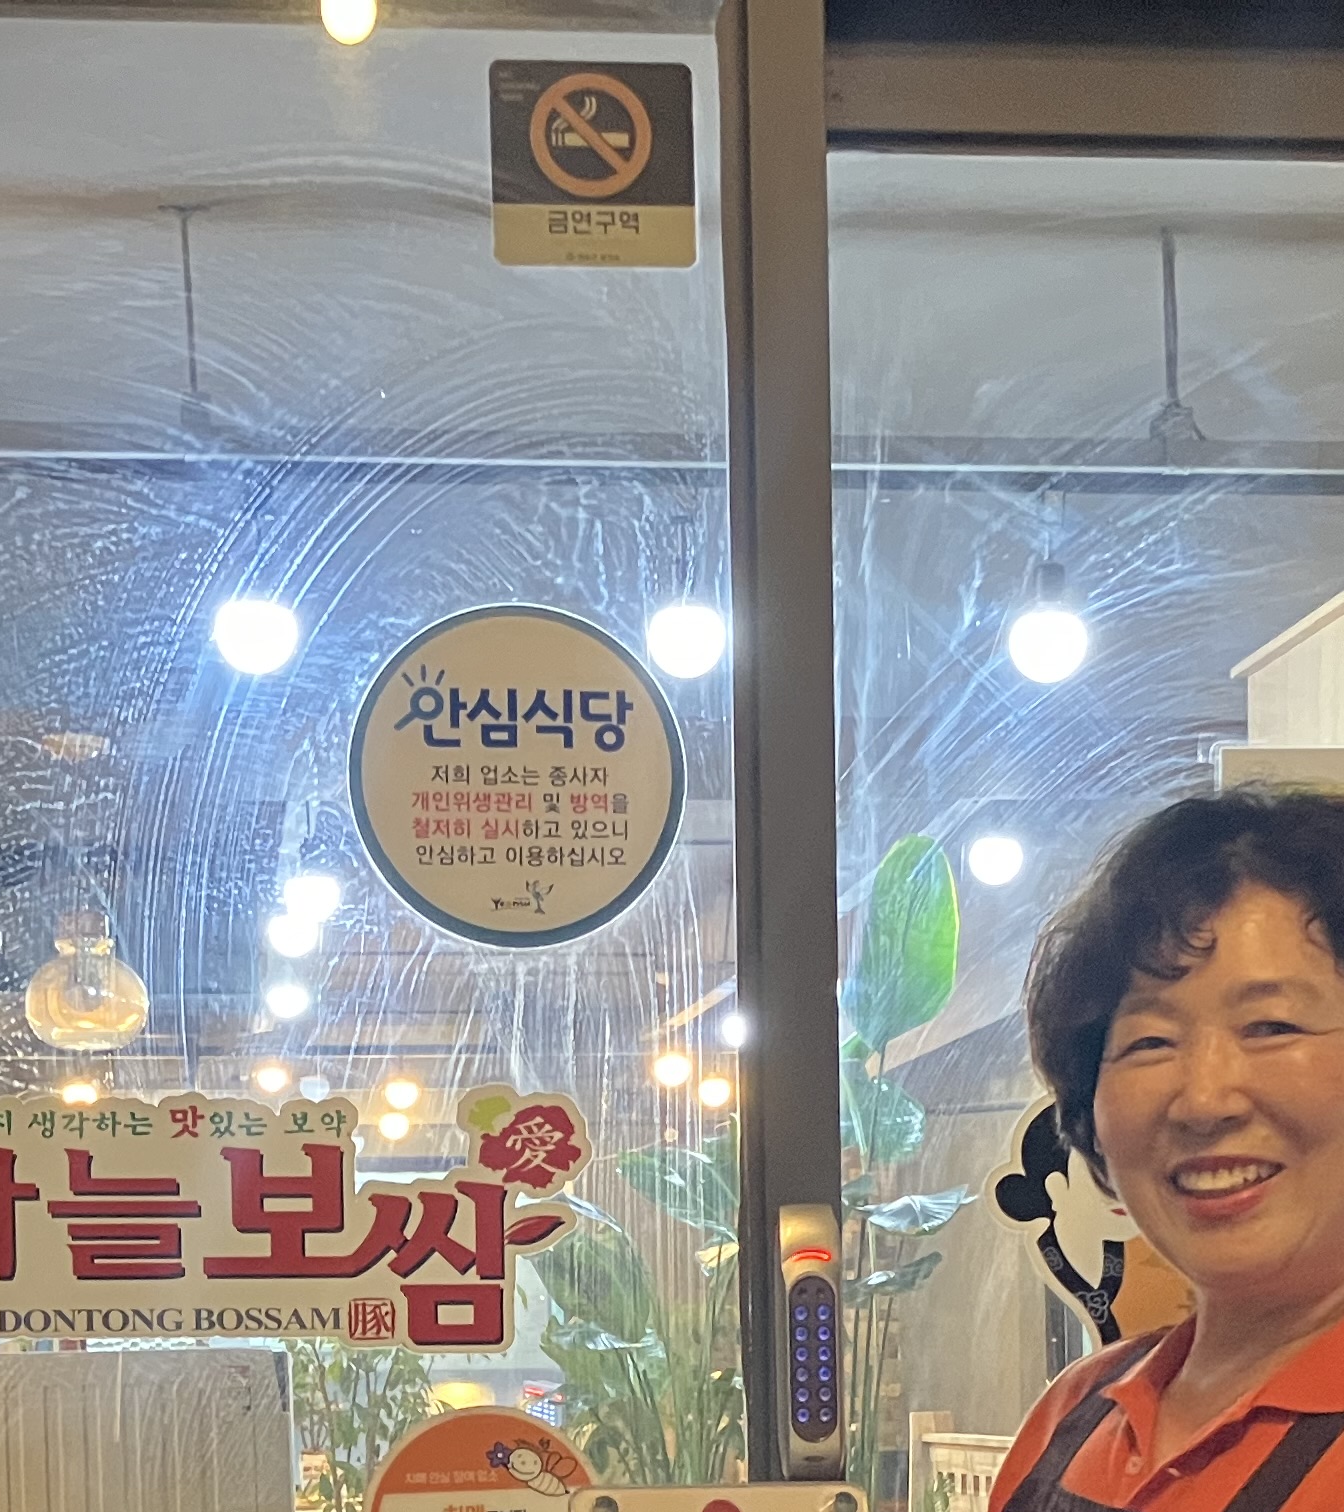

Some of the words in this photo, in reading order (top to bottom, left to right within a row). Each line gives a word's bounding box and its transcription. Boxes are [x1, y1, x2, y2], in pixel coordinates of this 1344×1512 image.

[548, 210, 640, 235] 금연구역
[394, 684, 634, 752] 안심식당
[431, 765, 470, 785] 저희
[480, 765, 540, 785] 업소는
[549, 766, 609, 787] 종사자
[412, 792, 533, 813] 개인위생관리
[543, 793, 561, 814] 및
[570, 793, 629, 815] 방역을
[411, 818, 472, 840] 철저히
[481, 818, 561, 840] 실시하고
[571, 820, 629, 841] 있으니
[415, 845, 496, 866] 안심하고
[506, 846, 627, 867] 이용하십시오
[29, 1109, 154, 1140] 생각하는
[170, 1106, 269, 1140] 맛있는
[284, 1110, 348, 1137] 보약
[192, 1307, 342, 1333] BOSSAM
